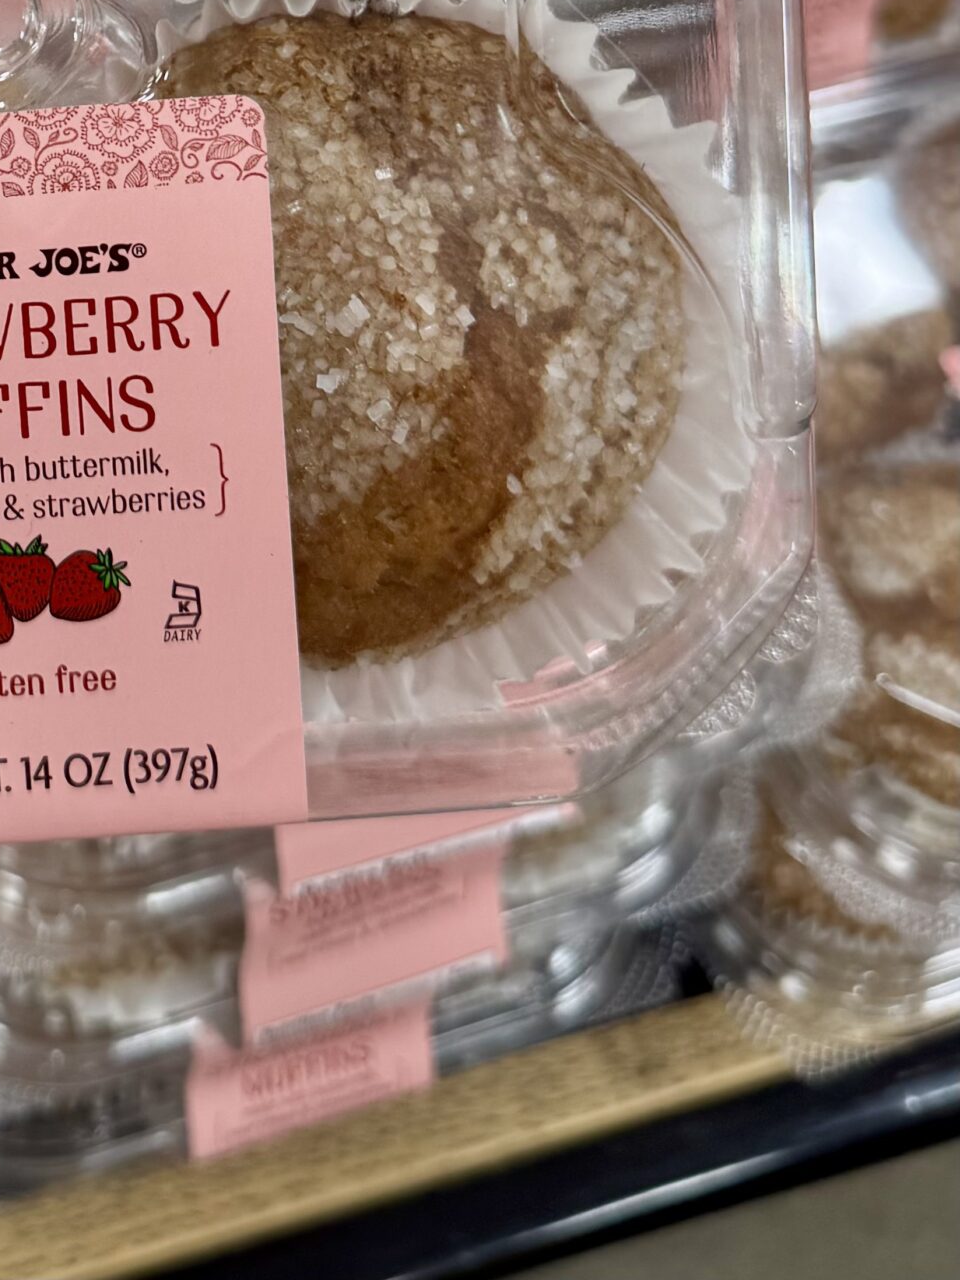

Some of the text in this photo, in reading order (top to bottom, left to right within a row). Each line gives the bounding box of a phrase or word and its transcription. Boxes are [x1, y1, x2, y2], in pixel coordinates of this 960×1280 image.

[25, 448, 170, 483] buttermilk,
[3, 494, 24, 520] &
[33, 487, 206, 518] strawberries
[163, 629, 202, 642] DAIRY
[55, 664, 117, 694] free
[21, 755, 53, 789] 14
[63, 752, 113, 788] OZ
[123, 744, 219, 794] (397g)
